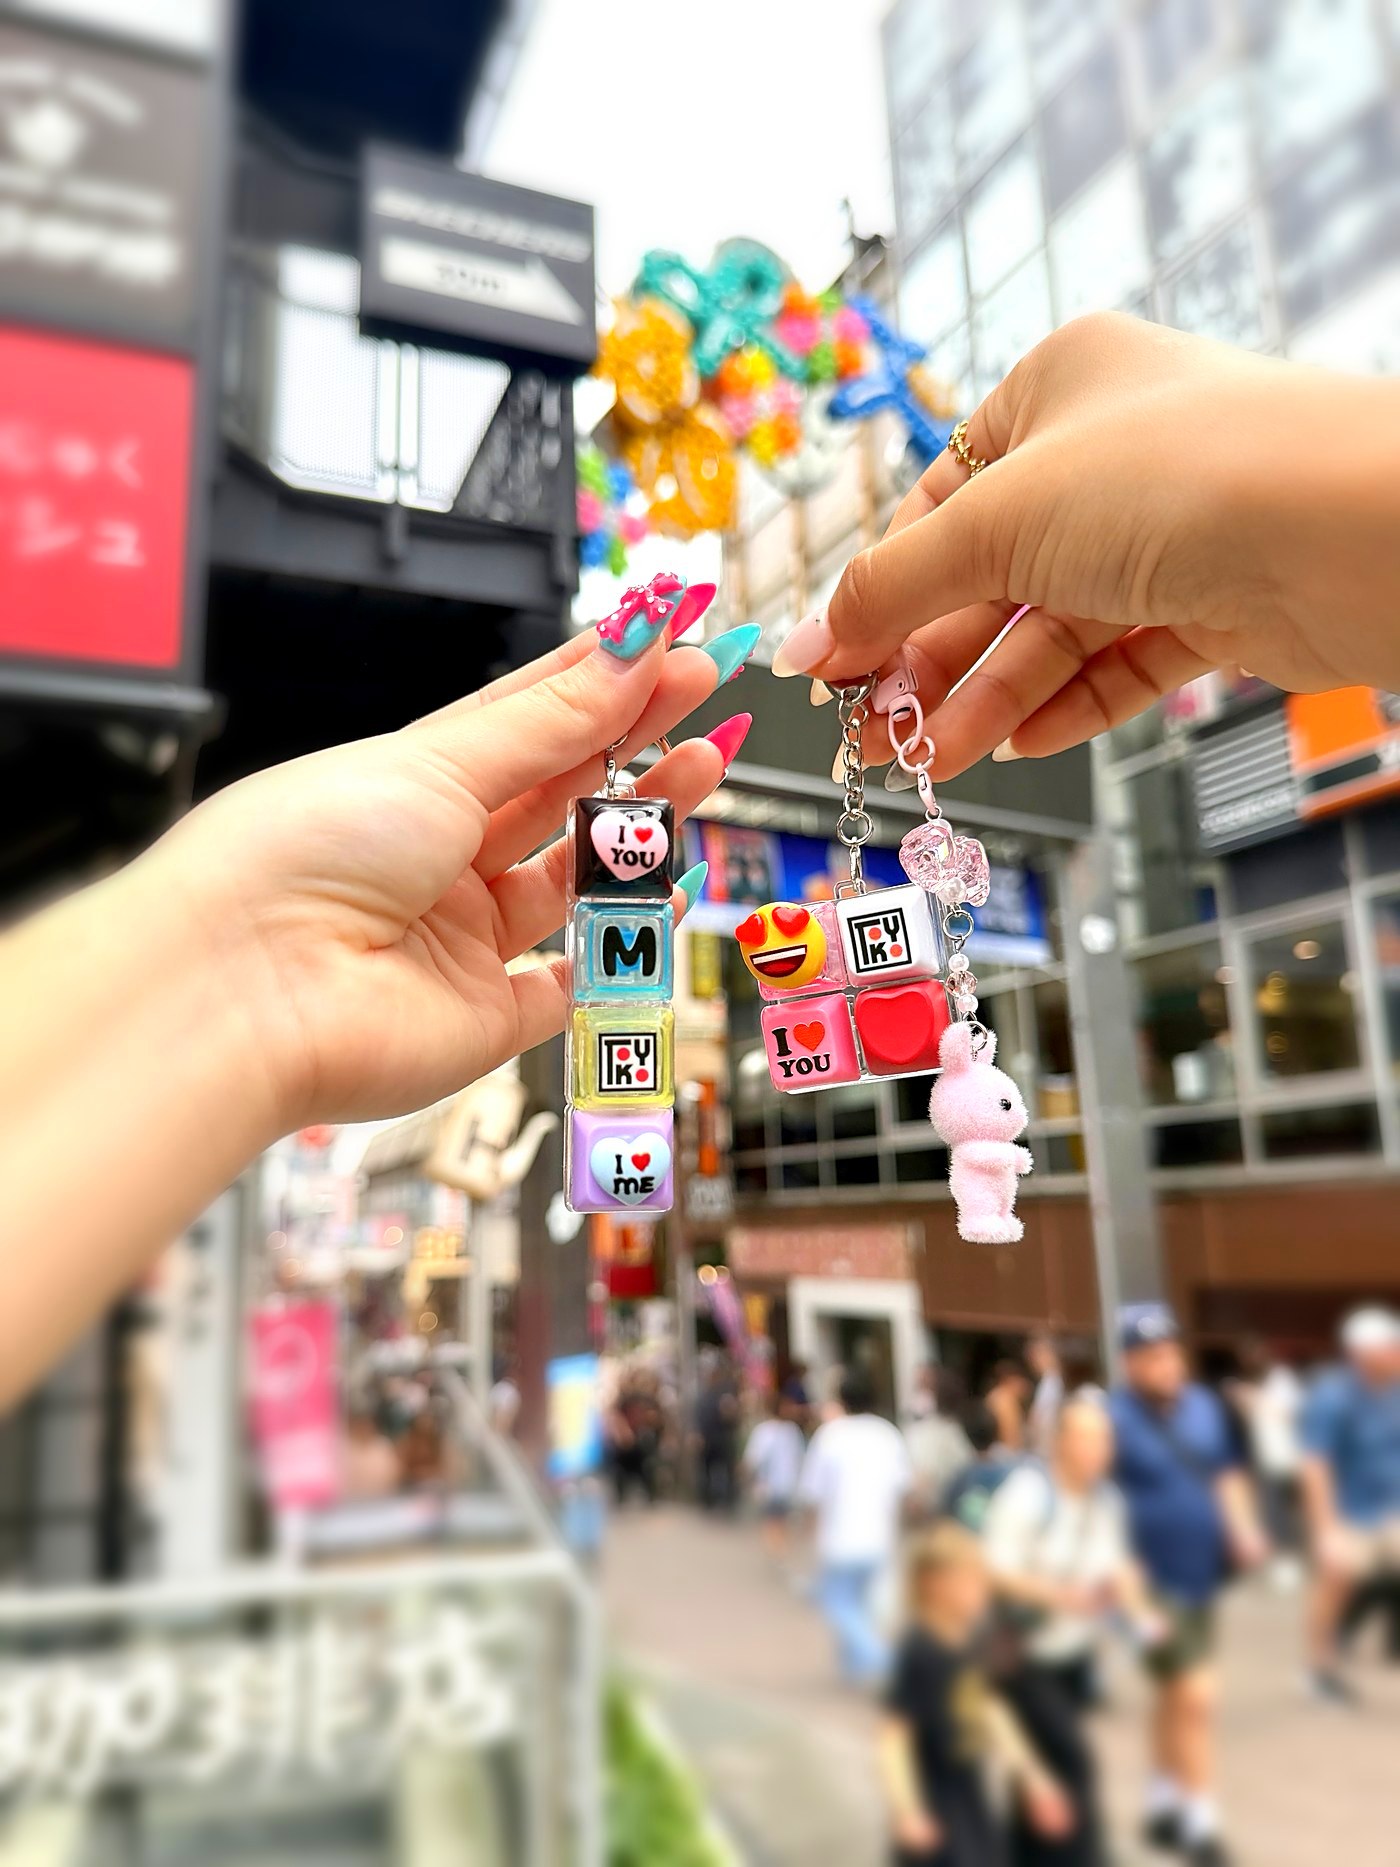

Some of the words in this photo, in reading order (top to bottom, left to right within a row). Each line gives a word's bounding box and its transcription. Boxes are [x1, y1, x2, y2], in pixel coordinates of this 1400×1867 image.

[618, 825, 625, 844] I
[611, 847, 655, 869] YOU
[602, 926, 656, 976] M
[771, 1027, 793, 1057] I
[777, 1053, 831, 1078] YOU
[615, 1154, 624, 1175] I
